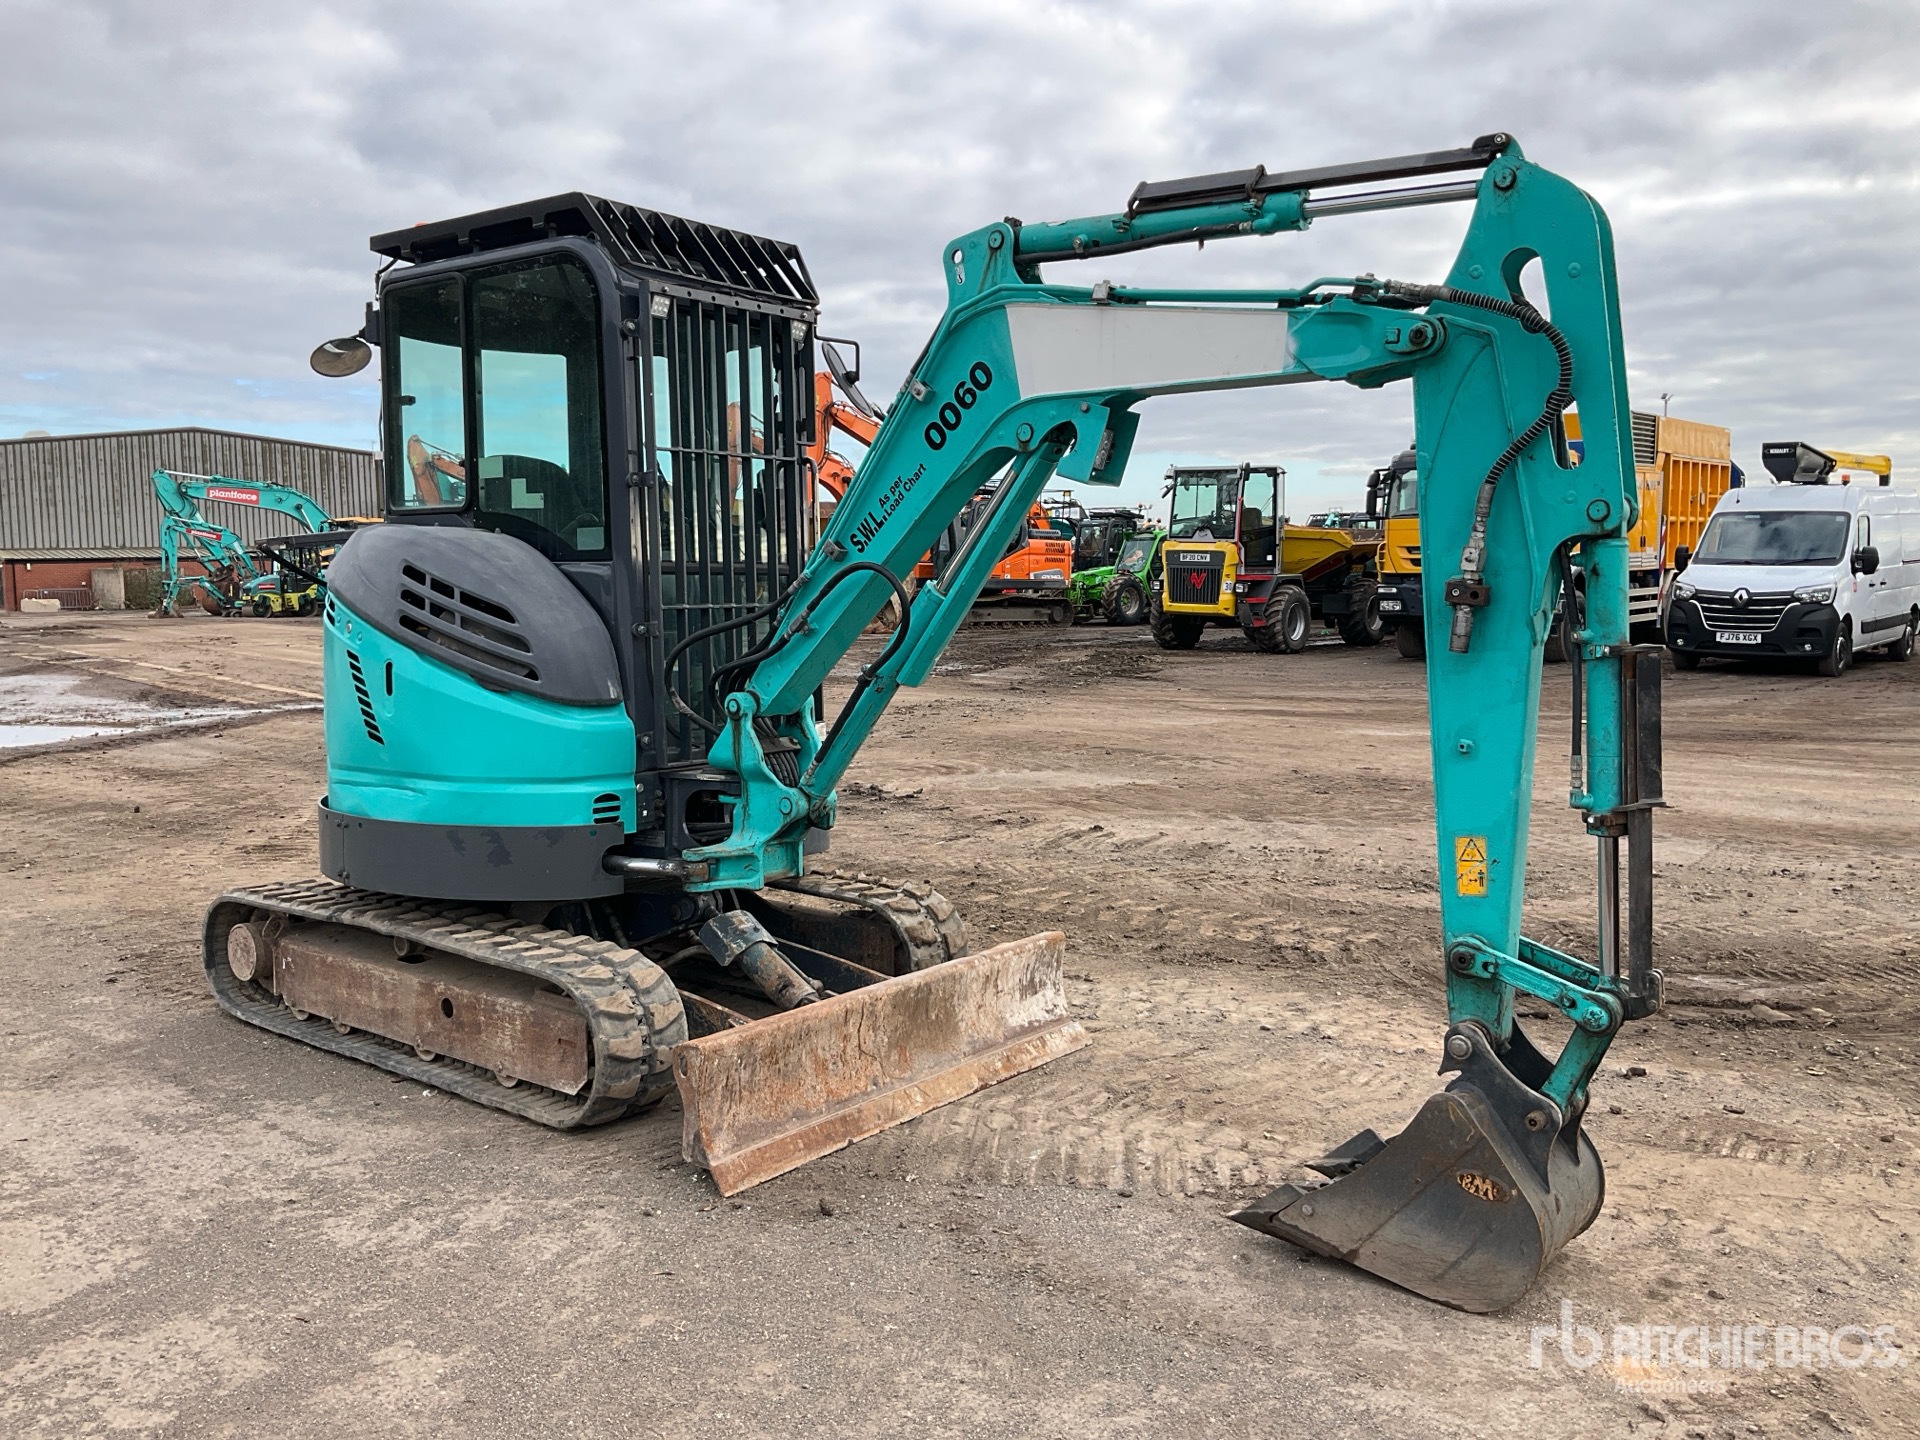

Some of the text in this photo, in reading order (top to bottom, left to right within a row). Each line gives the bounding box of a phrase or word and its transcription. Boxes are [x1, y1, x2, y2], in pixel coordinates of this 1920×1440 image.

[924, 361, 993, 451] 0060
[209, 489, 258, 501] plantforce
[878, 475, 903, 509] As per
[884, 490, 905, 517] Load
[903, 463, 927, 492] Chart
